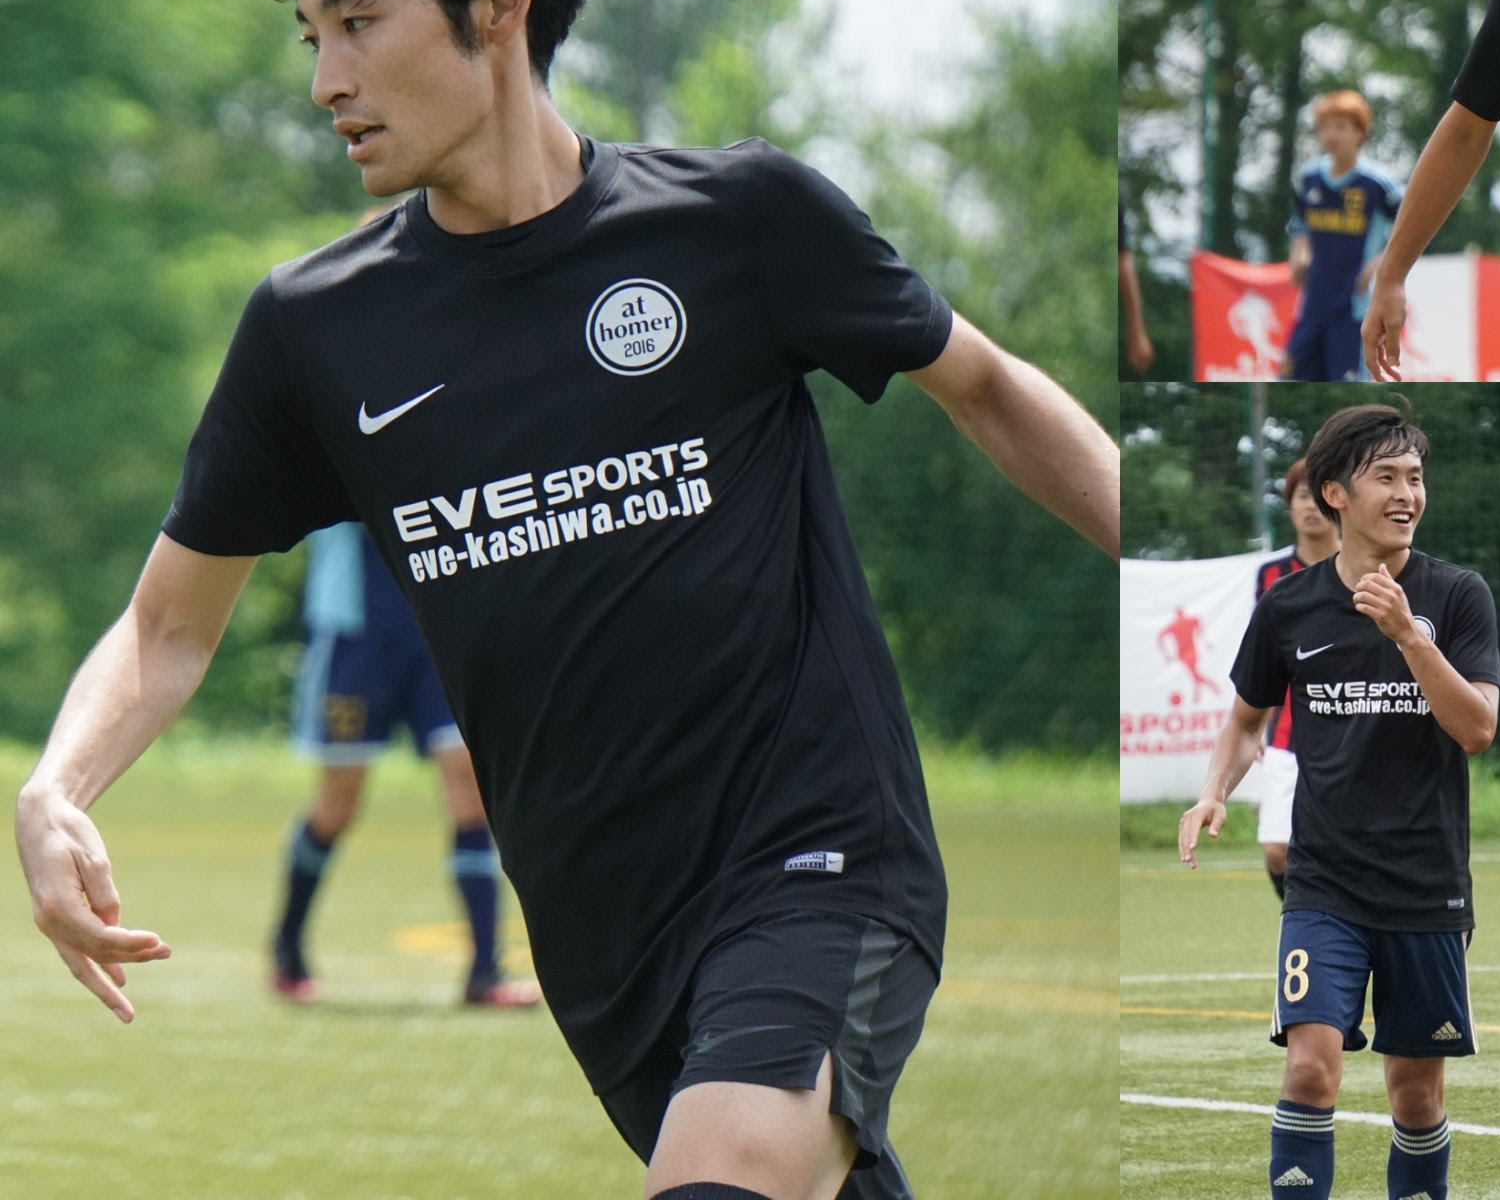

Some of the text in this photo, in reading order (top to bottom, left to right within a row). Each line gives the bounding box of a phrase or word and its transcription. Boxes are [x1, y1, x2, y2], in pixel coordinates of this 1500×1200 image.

[621, 295, 648, 318] at
[599, 313, 673, 342] homer
[623, 338, 656, 358] 2016
[393, 437, 709, 543] EVE SPORTS
[408, 476, 713, 583] eve-kashiwa.co.jp
[1306, 680, 1425, 699] EVE SPORT
[1309, 696, 1431, 716] eve-kashiwa.co.jp
[1283, 948, 1310, 1003] 8
